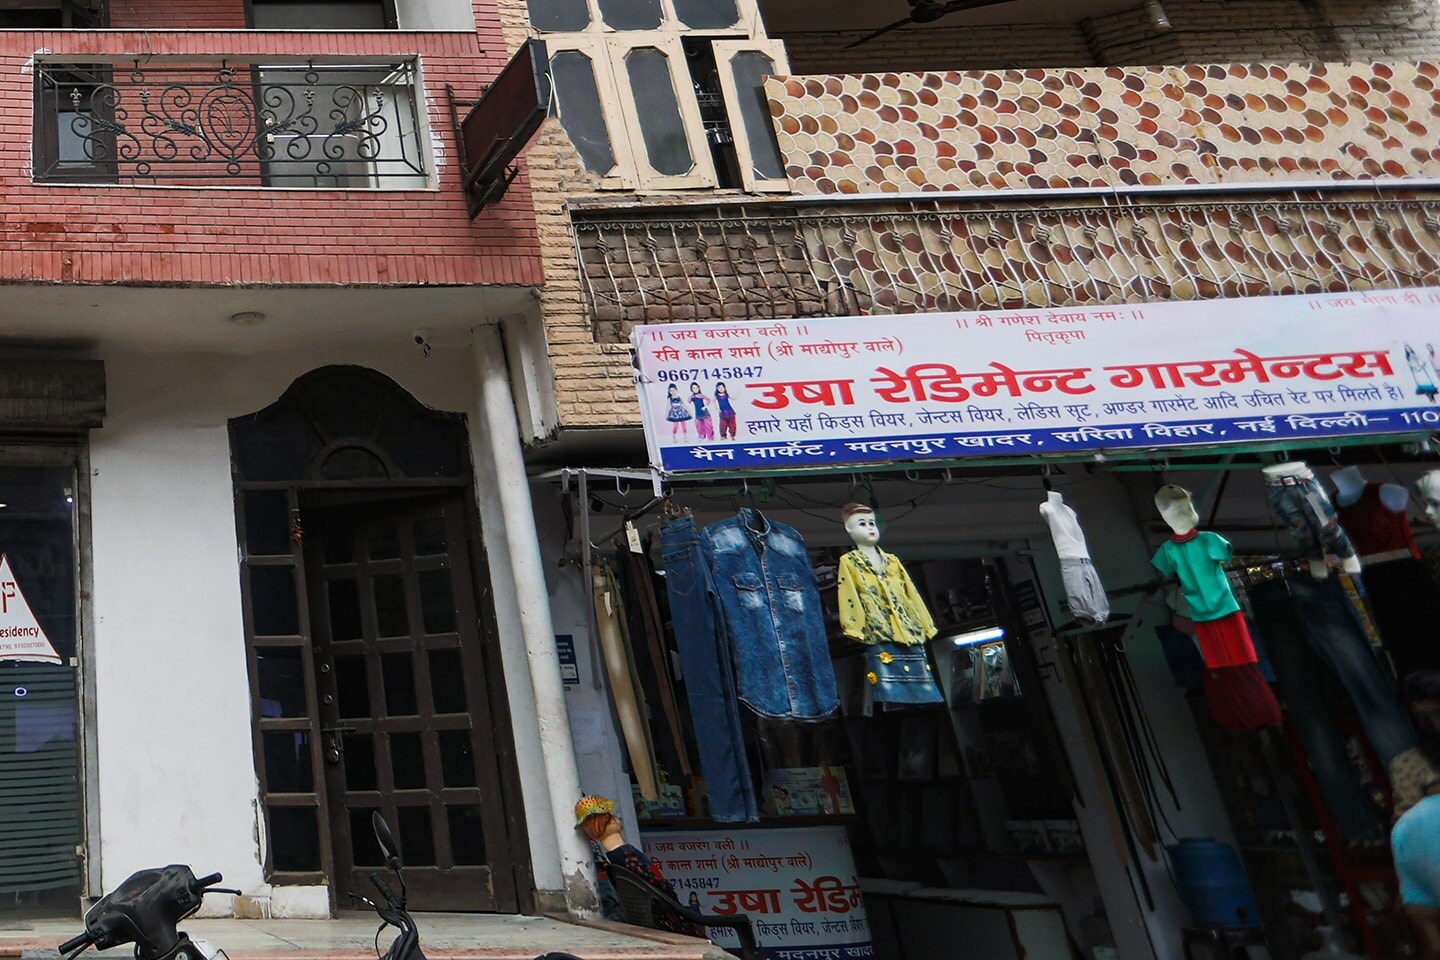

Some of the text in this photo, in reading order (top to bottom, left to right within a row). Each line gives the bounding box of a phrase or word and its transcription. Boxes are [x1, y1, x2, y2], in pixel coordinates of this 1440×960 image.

[975, 313, 994, 328] श्री
[998, 314, 1040, 327] गणेश
[1046, 310, 1087, 325] देवाय
[670, 329, 697, 341] जय
[652, 347, 679, 363] रवि
[685, 347, 723, 361] कान्त
[729, 342, 761, 360] शर्मा
[656, 366, 764, 383] 9667145847
[745, 348, 1395, 410] उषा रेडिमेन्ट गारमेन्टस
[745, 416, 782, 436] हमारे
[786, 413, 814, 432] यहाँ
[917, 407, 962, 426] जेन्टस
[1203, 393, 1239, 410] आदि
[1244, 390, 1286, 409] उचित
[1290, 389, 1310, 405] रेट
[1314, 388, 1334, 403] पर
[1337, 383, 1382, 402] मिलते
[690, 446, 734, 462] मैन
[839, 439, 951, 456] मदनपुर
[1054, 425, 1142, 445] सरिता
[1234, 415, 1275, 433] नई
[656, 841, 674, 852] जय
[666, 859, 692, 871] कान्त
[696, 855, 718, 871] शर्मा
[707, 888, 782, 916] उषा
